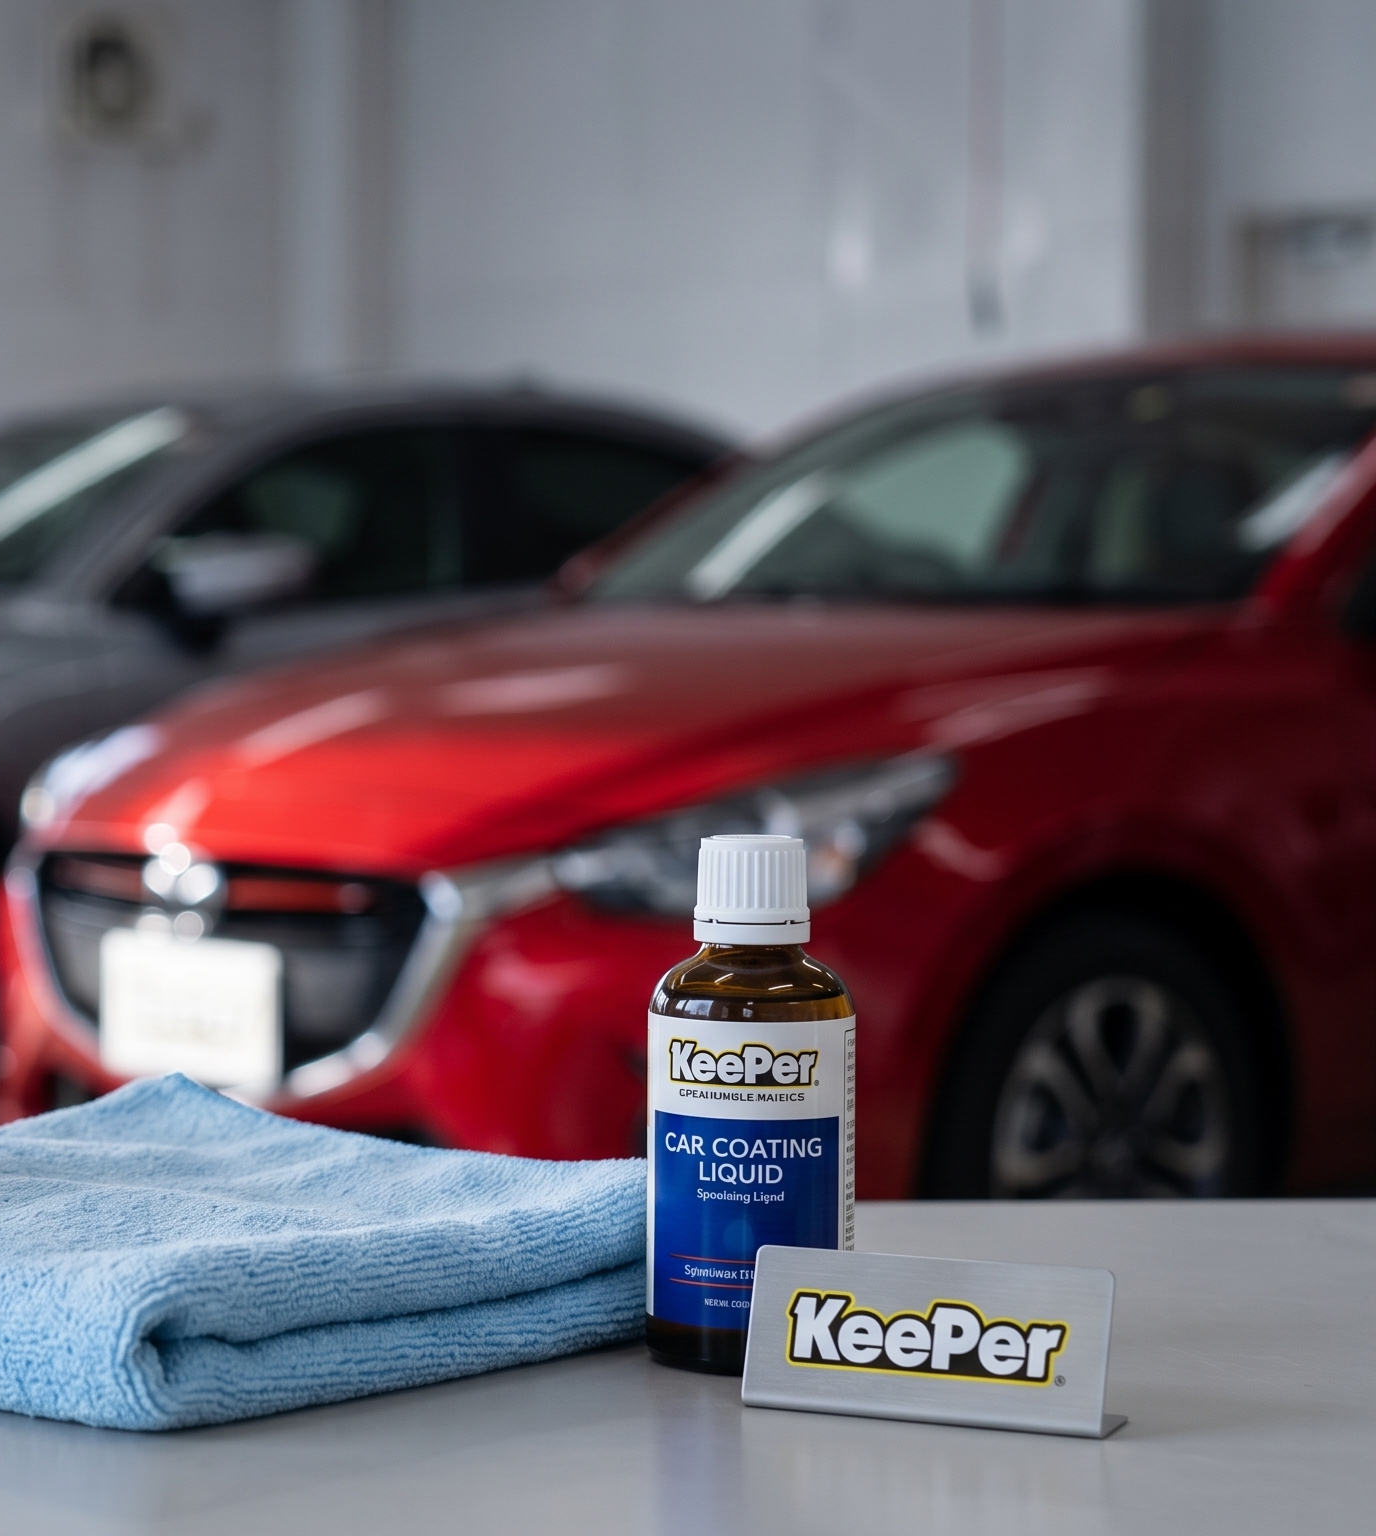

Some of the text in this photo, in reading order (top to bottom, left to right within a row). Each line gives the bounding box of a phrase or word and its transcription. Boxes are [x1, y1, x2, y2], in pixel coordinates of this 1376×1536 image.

[669, 1037, 818, 1086] KeePer
[665, 1132, 706, 1156] CAR
[712, 1137, 822, 1159] COATING
[699, 1161, 783, 1185] LIQUID
[791, 1292, 1066, 1382] KeePer
